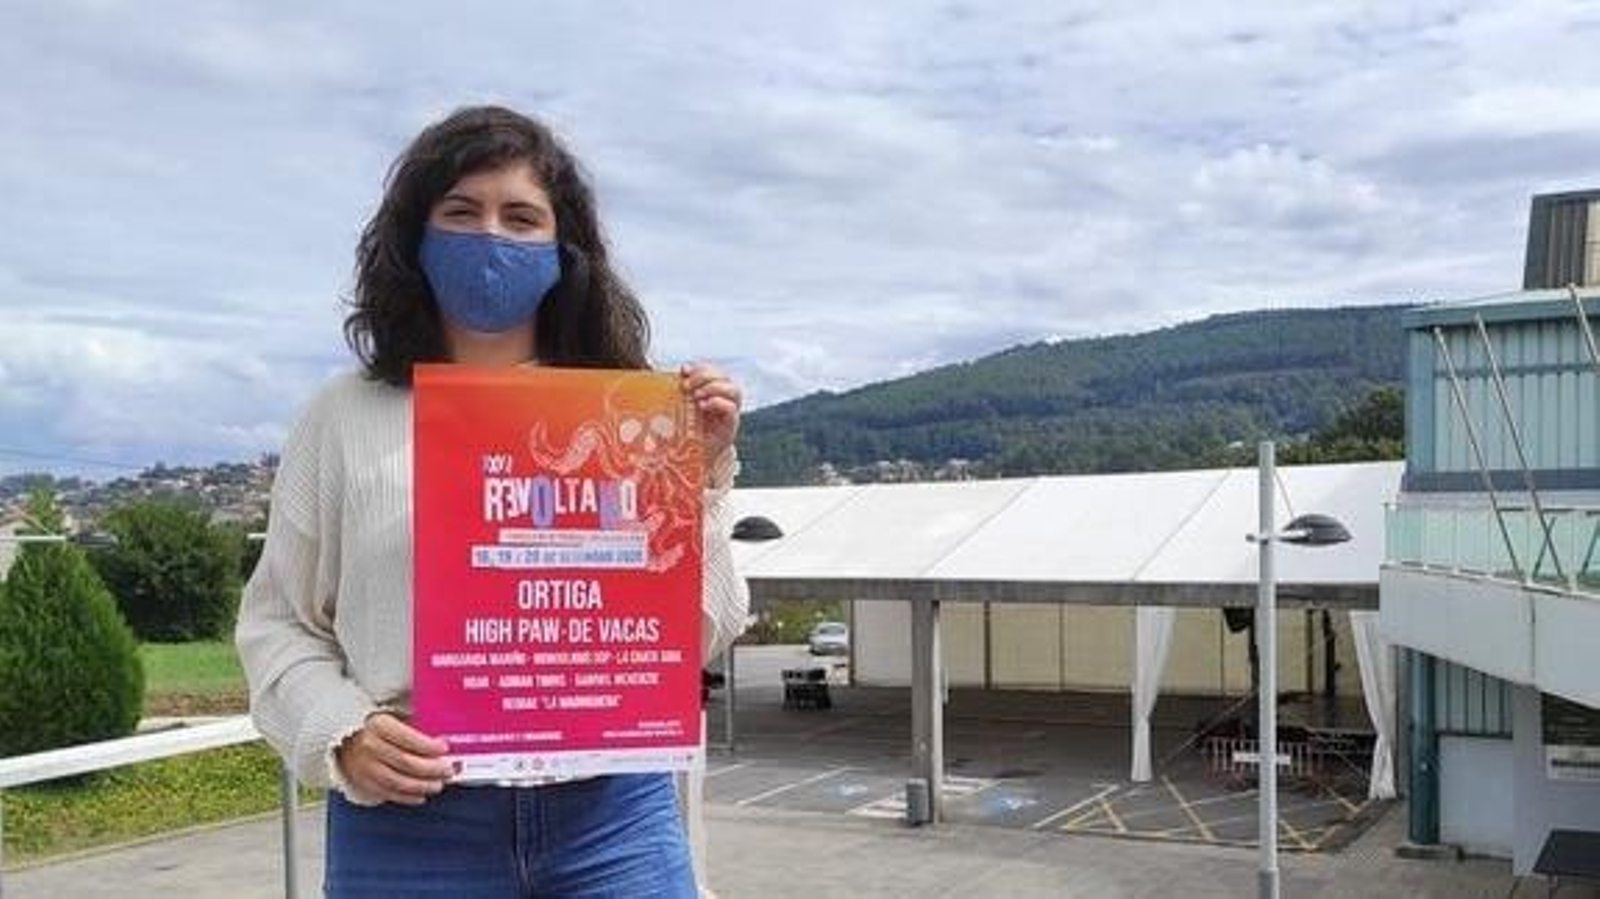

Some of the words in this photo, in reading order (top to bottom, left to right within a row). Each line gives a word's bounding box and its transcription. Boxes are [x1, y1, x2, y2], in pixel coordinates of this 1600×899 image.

[517, 580, 603, 609] ORTIGA
[466, 618, 512, 643] HIGH
[599, 617, 660, 641] VACAS
